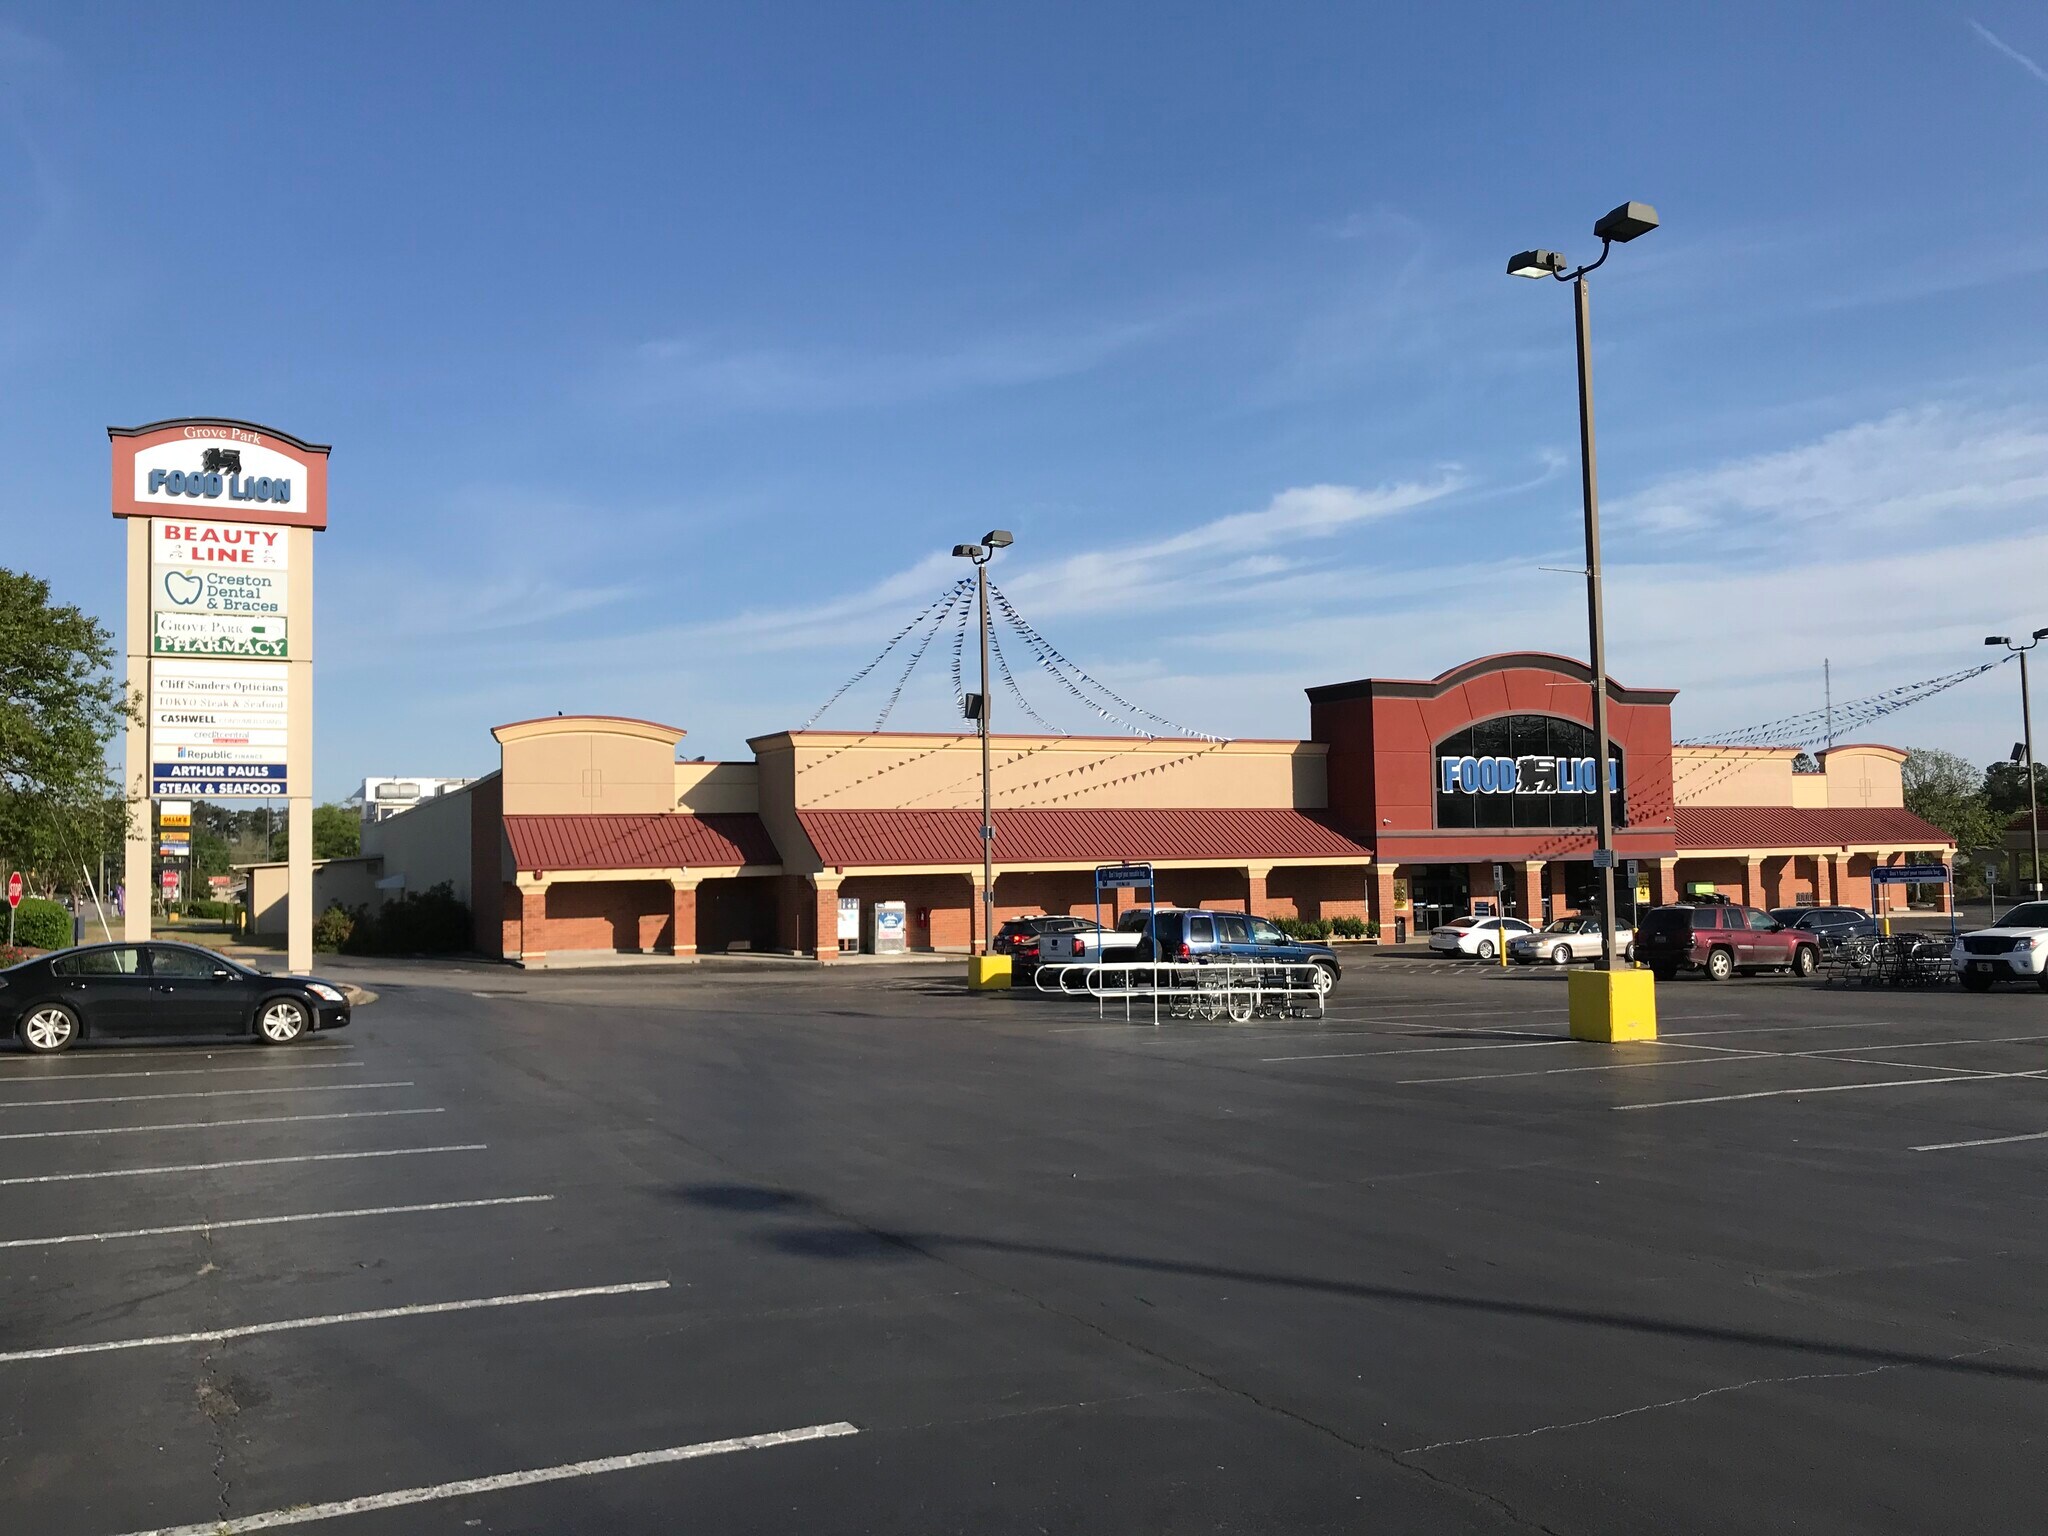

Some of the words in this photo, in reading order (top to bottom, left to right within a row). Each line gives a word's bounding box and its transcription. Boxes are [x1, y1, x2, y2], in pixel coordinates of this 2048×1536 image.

[184, 426, 226, 439] Grove
[231, 427, 261, 445] Park
[148, 469, 223, 498] FOOD
[229, 474, 291, 504] LION
[164, 525, 279, 546] BEAUTY
[191, 547, 255, 563] LINE
[206, 572, 272, 587] Creston
[206, 585, 261, 599] Dental
[206, 598, 218, 609] &
[223, 598, 278, 612] Braces
[212, 621, 243, 634] PARK
[160, 637, 285, 655] PHARMACY
[160, 679, 185, 690] Cliff
[187, 680, 231, 691] Sanders
[233, 681, 284, 693] Opticians
[160, 714, 216, 724] CASHWELL
[187, 749, 232, 760] Republic
[171, 765, 225, 777] ARTHUR
[227, 766, 269, 777] PAULS
[1441, 756, 1517, 794] FOOD
[159, 783, 201, 794] STEAK
[205, 784, 215, 794] &
[218, 784, 281, 794] SEAFOOD
[9, 882, 21, 897] STOP
